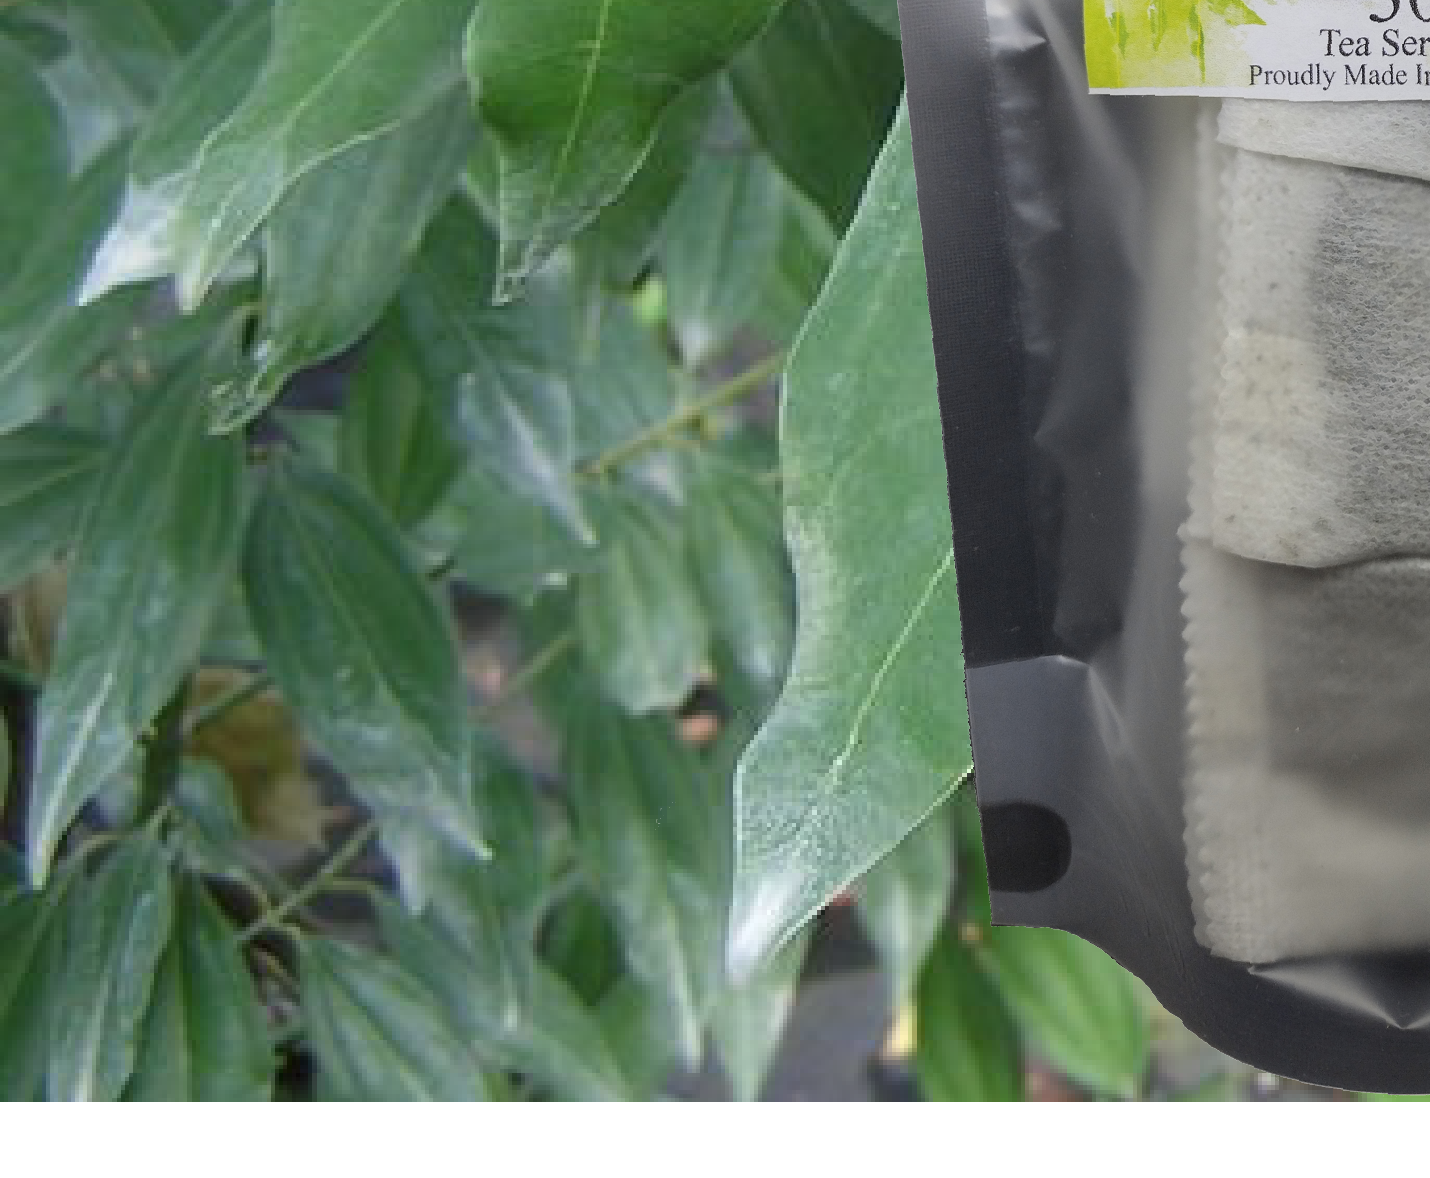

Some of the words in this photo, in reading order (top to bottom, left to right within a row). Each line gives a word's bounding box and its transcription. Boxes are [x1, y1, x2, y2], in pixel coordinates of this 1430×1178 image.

[1319, 28, 1372, 57] Tea
[1248, 64, 1337, 92] Proudly
[1343, 65, 1410, 87] Made
